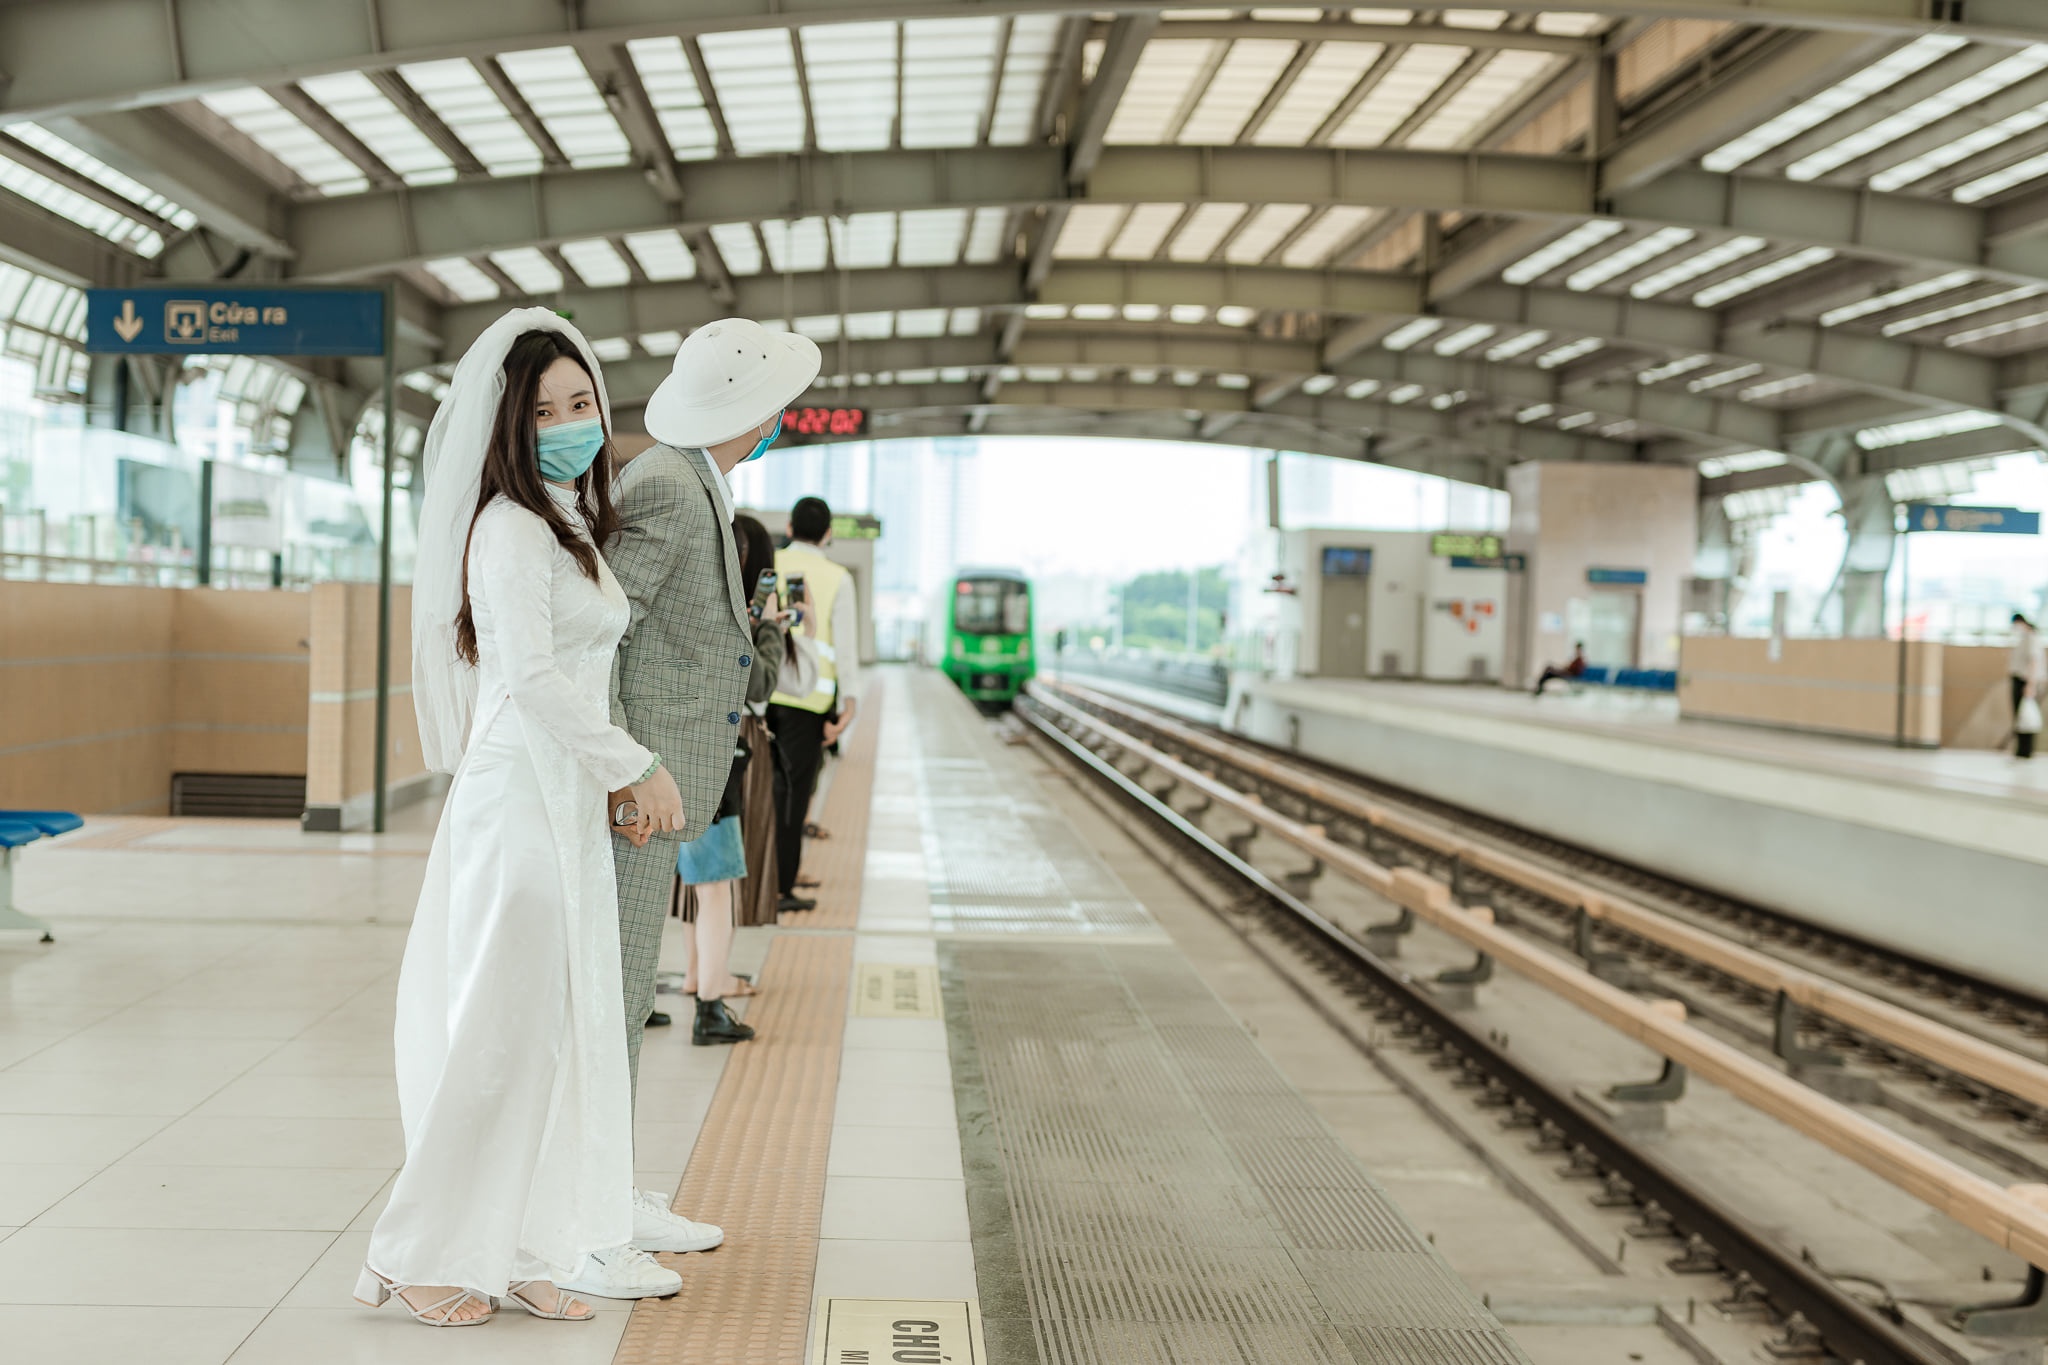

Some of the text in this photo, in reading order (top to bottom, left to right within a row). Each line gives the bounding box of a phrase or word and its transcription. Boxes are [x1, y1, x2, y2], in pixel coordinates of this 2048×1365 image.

[210, 301, 287, 325] Cửa ra
[209, 327, 239, 343] Exit
[892, 1319, 952, 1364] CHÚ
